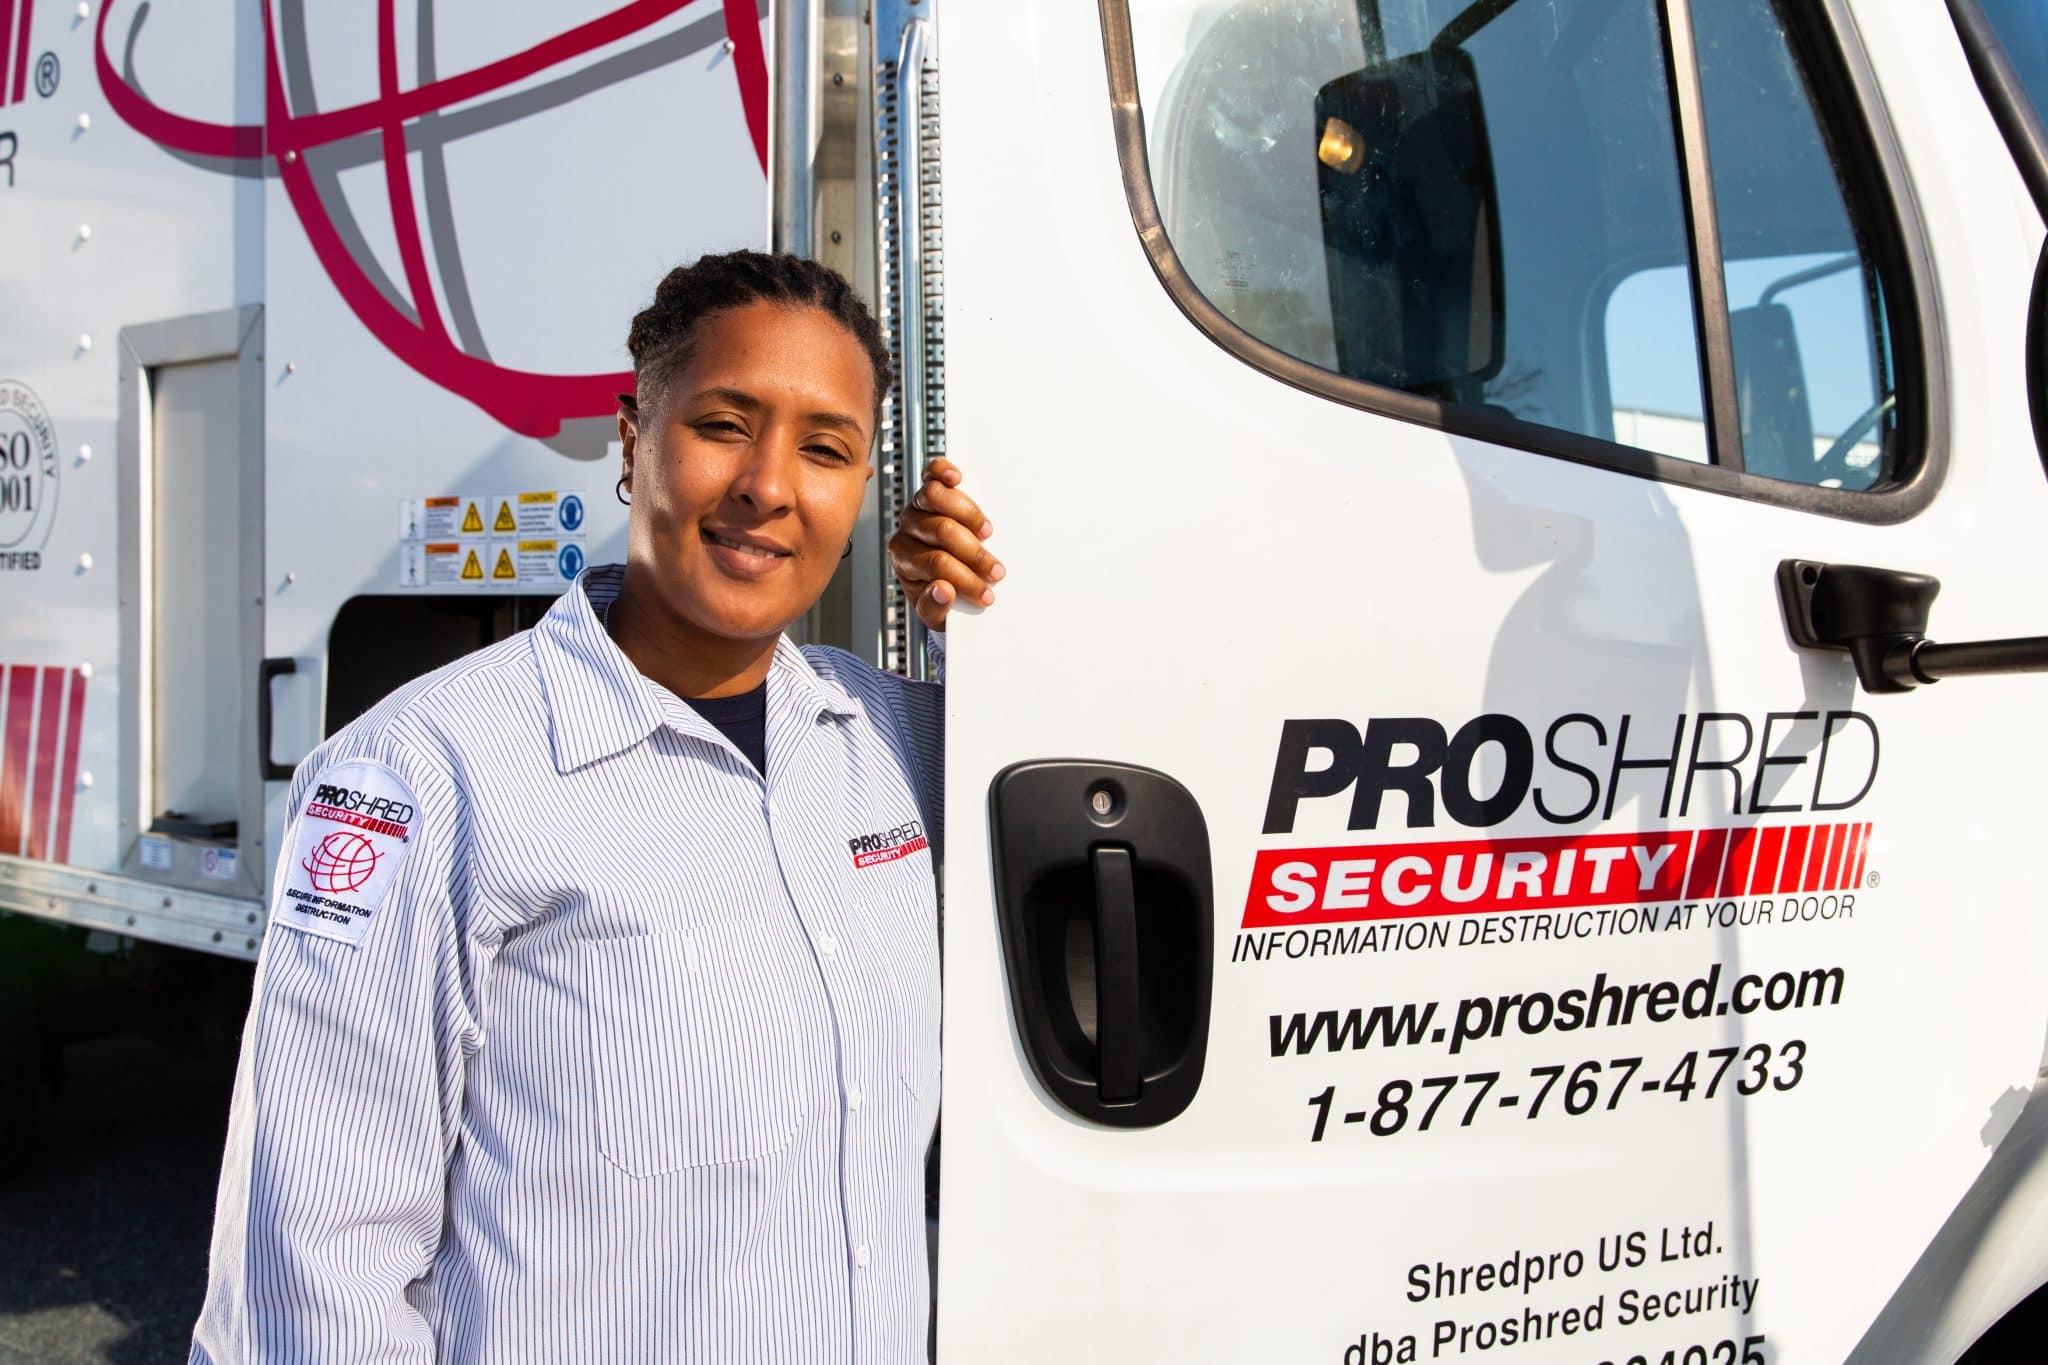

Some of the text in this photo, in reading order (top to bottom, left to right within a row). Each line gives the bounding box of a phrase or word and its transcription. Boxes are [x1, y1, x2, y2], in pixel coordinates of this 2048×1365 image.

[312, 784, 413, 825] PROSHRED
[1261, 712, 1880, 834] PROSHRED
[307, 804, 369, 827] SECURITY
[849, 820, 922, 856] PROSHRED
[857, 849, 901, 866] SECURITY
[1265, 843, 1678, 914] SECURITY
[286, 888, 372, 918] SECURE INFORMATION
[295, 903, 351, 925] DESTRUCTION
[1231, 895, 1855, 963] INFORMATION DESTRUCTION AT YOUR DOOR
[1268, 963, 1845, 1058] www.proshred.com
[1306, 1040, 1806, 1142] 1-877-767-4733
[1406, 1221, 1722, 1302] Shredpro US Ltd.
[1343, 1274, 1760, 1365] dba Proshred Security
